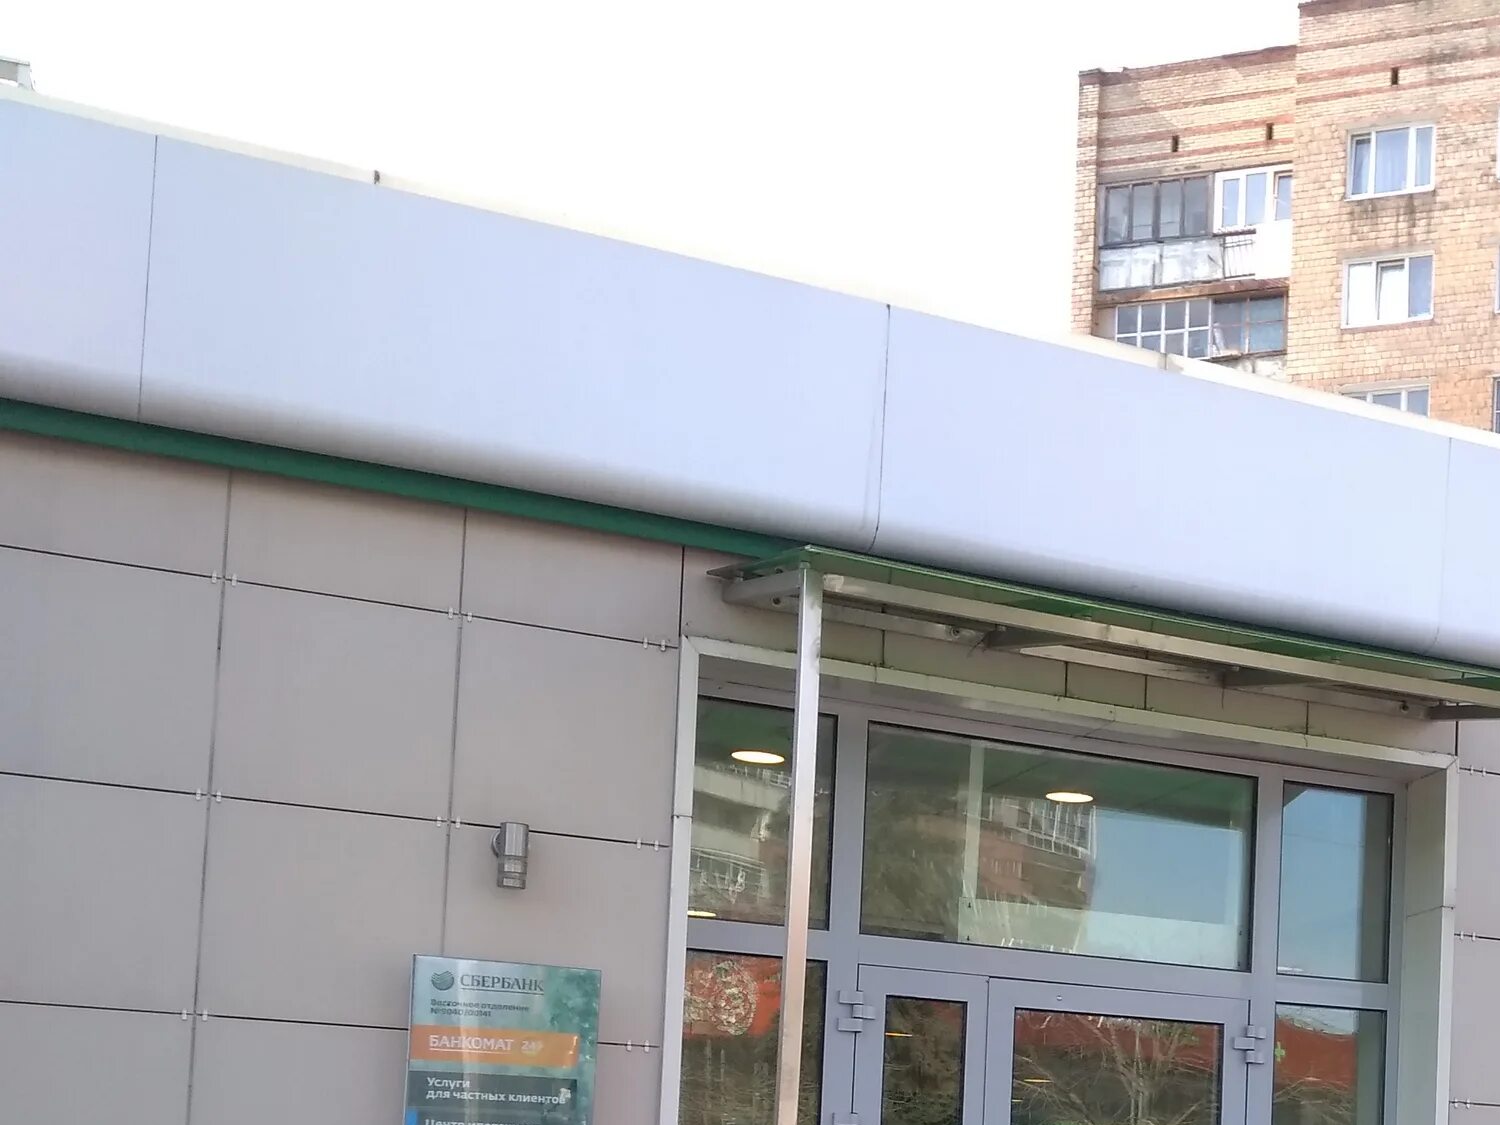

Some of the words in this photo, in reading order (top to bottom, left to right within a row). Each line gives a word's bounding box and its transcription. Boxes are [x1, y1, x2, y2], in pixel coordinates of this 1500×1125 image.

[460, 974, 545, 992] СБЕРБАНК
[429, 1034, 514, 1050] БАНКОМАТ
[427, 1077, 470, 1089] Услуги
[426, 1090, 450, 1100] для
[452, 1091, 505, 1102] частных
[508, 1093, 566, 1104] клиентов
